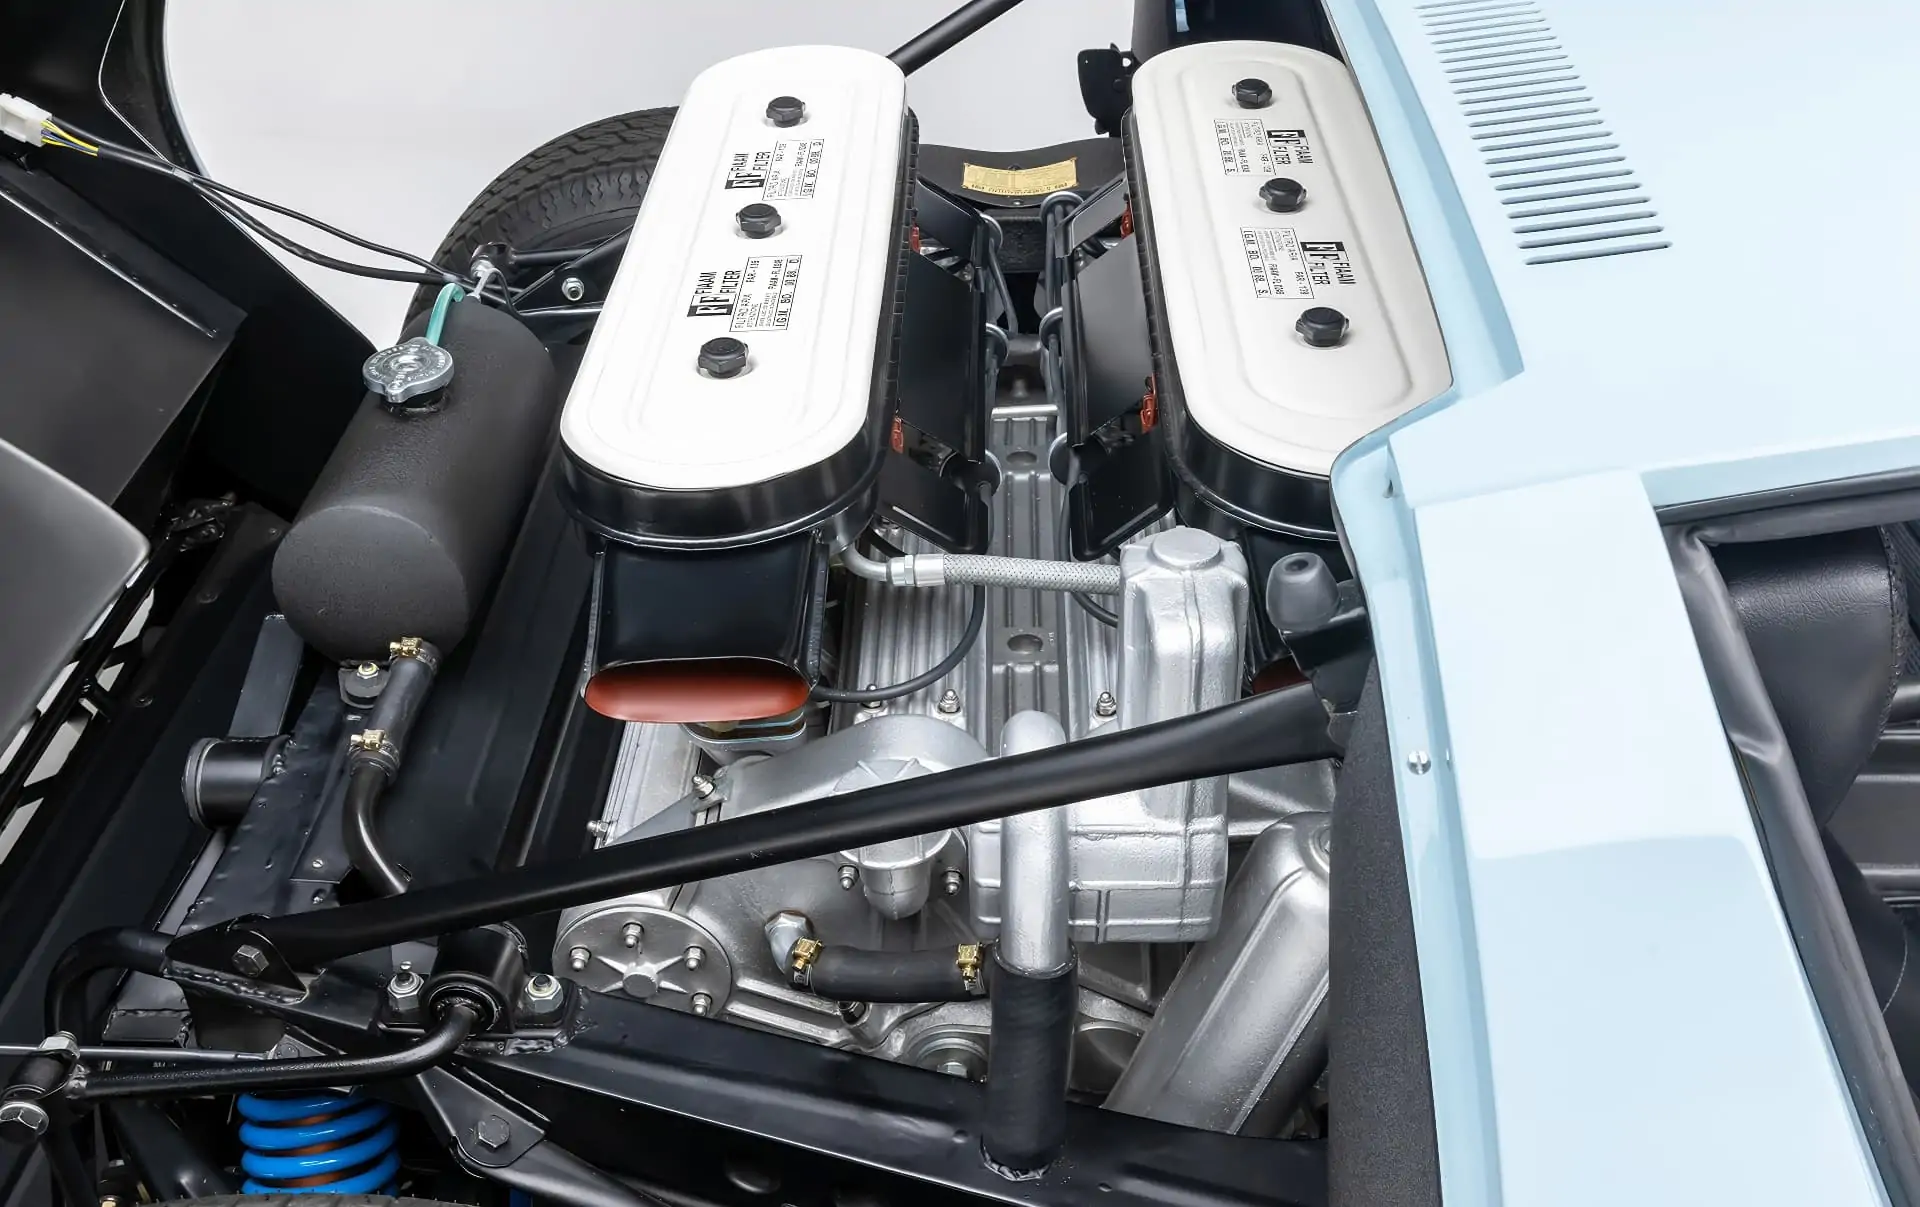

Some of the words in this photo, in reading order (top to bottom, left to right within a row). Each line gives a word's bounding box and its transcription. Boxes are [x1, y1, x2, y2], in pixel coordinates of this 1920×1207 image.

[752, 151, 771, 170] FILTER
[1271, 146, 1291, 164] FILTER
[694, 271, 717, 294] FIAAM
[719, 270, 741, 293] FILTER
[1308, 262, 1330, 284] FILTER
